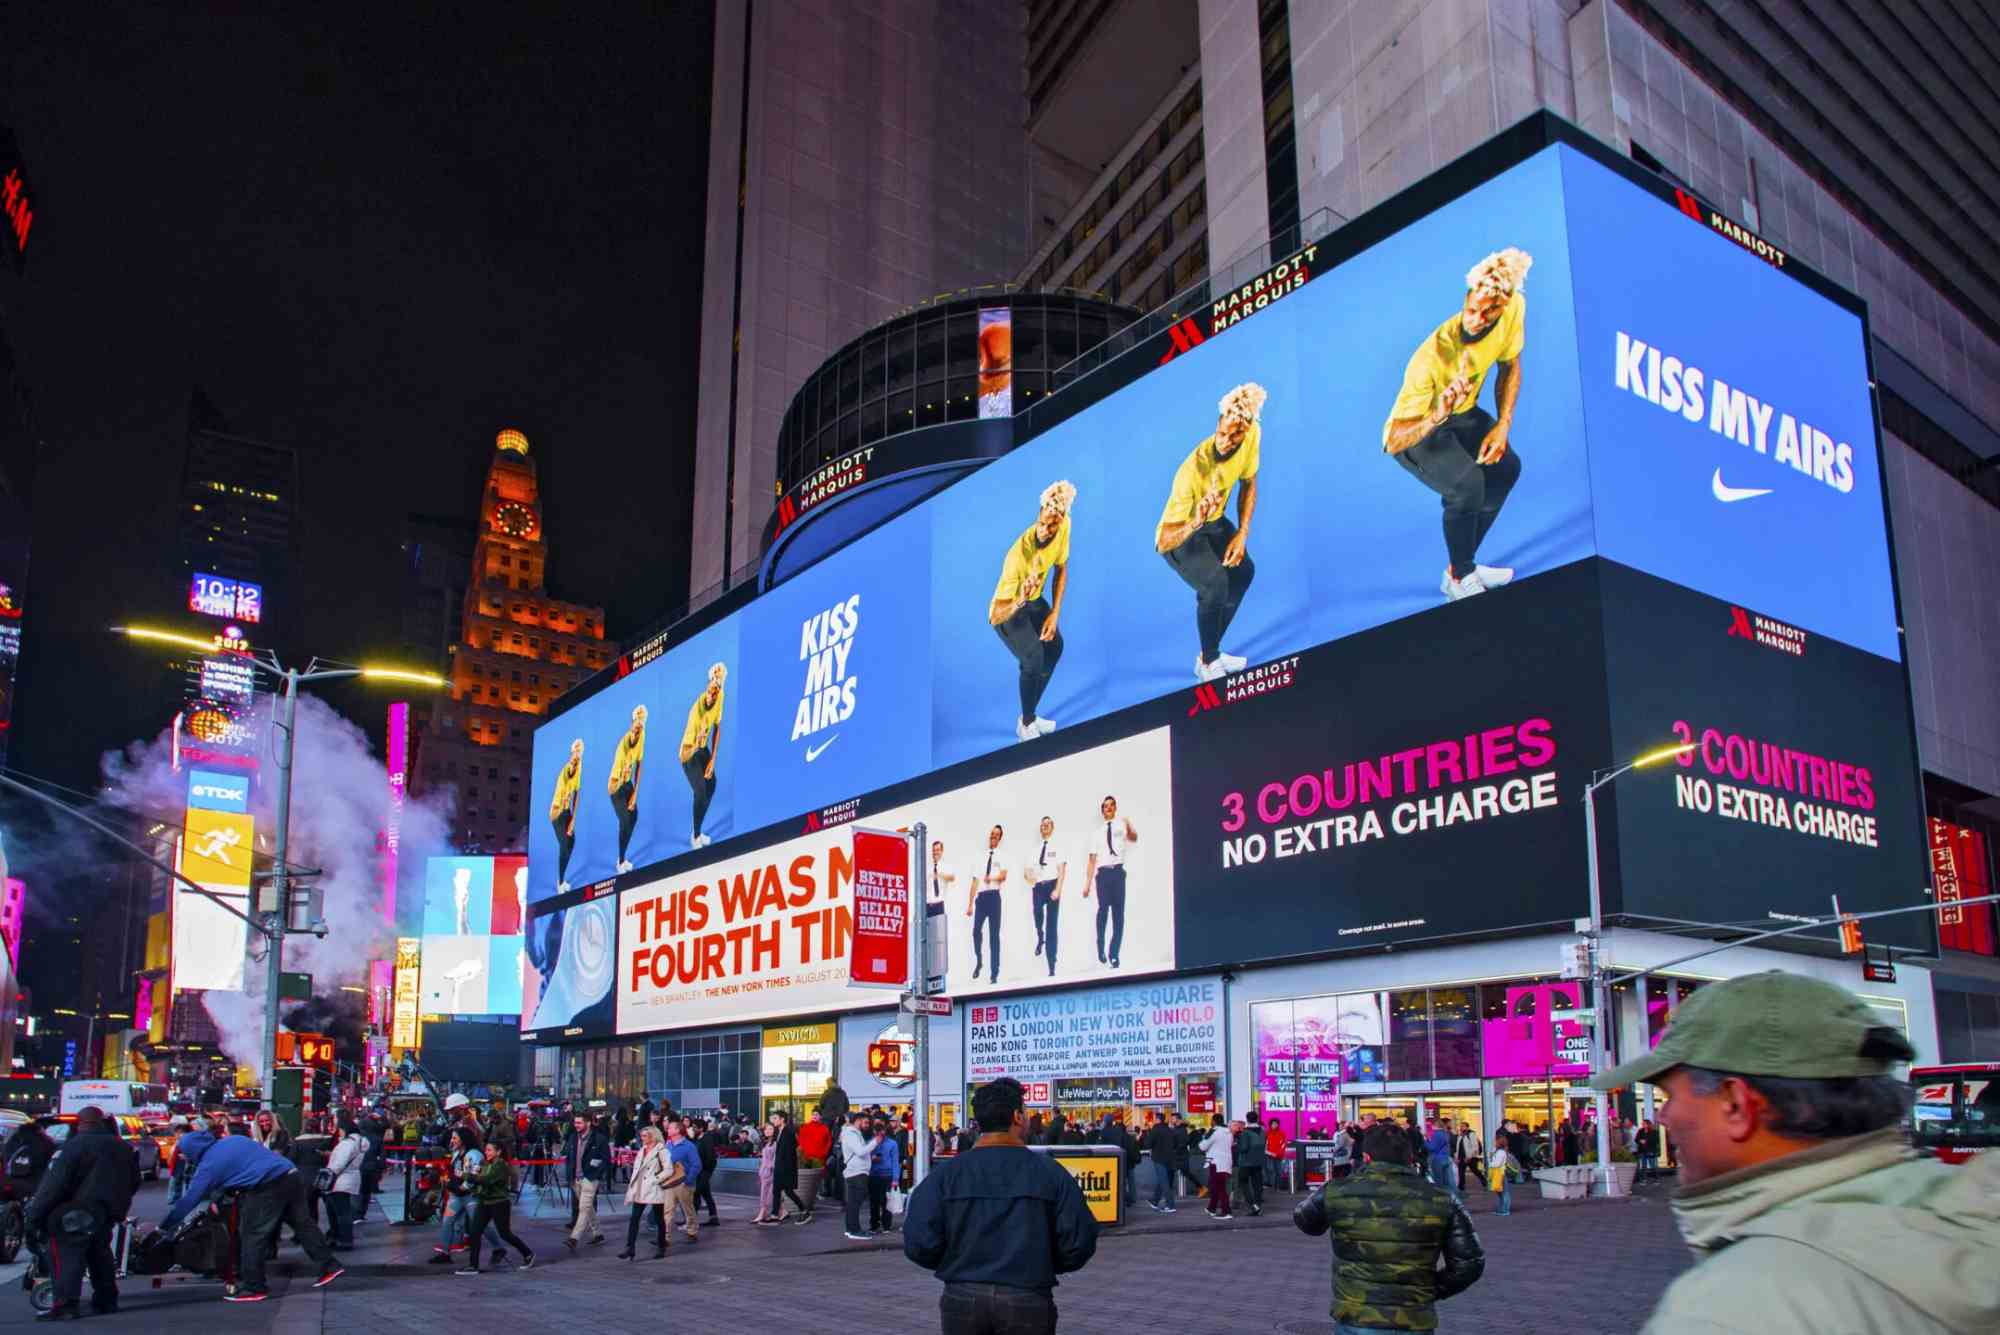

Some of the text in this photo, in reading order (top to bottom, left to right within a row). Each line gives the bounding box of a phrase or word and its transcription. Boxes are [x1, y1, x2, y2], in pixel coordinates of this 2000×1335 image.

[1711, 212, 1785, 266] MARRIOTT
[1213, 246, 1318, 317] MARRIOTT
[1213, 272, 1305, 333] MARQUIS
[1615, 330, 1854, 493] KISS MY AIRS
[802, 448, 874, 496] MARRIOTT
[801, 468, 863, 510] MARQUIS
[800, 594, 860, 662] KISS
[1755, 616, 1806, 642] MARRIOTT
[633, 632, 668, 659] MARRIOTT
[1756, 630, 1802, 655] MARQUIS
[804, 636, 855, 697] MY
[1226, 657, 1300, 689] MARRIOTT
[1226, 673, 1291, 701] MARQUIS
[791, 675, 857, 742] AIRS
[205, 732, 243, 746] 2017
[1221, 718, 1557, 832] 3 COUNTRIES
[1672, 720, 1876, 810] 3 COUNTRIES
[204, 785, 244, 801] TDK
[823, 799, 861, 817] MARRIOTT
[823, 809, 856, 826] MARQUIS
[1222, 771, 1558, 868] NO EXTRA CHARGE
[1675, 774, 1713, 814] NO
[1716, 783, 1792, 830] EXTRA
[1793, 801, 1878, 848] CHARGE
[718, 855, 816, 925] WAS
[829, 846, 854, 900] M
[858, 869, 905, 888] BETTE
[856, 883, 907, 903] MIDLER
[631, 920, 781, 993] FOURTH
[705, 987, 721, 999] THE
[721, 984, 740, 996] NEW
[741, 981, 764, 993] YORK
[766, 976, 791, 989] TIMES
[795, 969, 833, 984] AUGUST
[1003, 1001, 1051, 1020] TOKYO
[1056, 998, 1075, 1015] TO
[1083, 991, 1132, 1013] TIMES
[1140, 983, 1215, 1009] SQUARE
[971, 1005, 1214, 1040] PARIS LONDON NEW YORK UNIQLO
[971, 1025, 1215, 1053] HONG KONG TORONTO SHANGHAI CHICAGO
[971, 1041, 1215, 1065] LOS ANGELES SINGAPORE ANTWERP SEOUL MELBOURNE
[1566, 1038, 1589, 1049] ONE
[888, 1051, 899, 1068] 10
[1091, 1060, 1120, 1068] MOSCOW
[1155, 1057, 1170, 1066] SAN
[1172, 1055, 1215, 1065] FRANCISCO
[1268, 1061, 1285, 1073] ALL
[1057, 1087, 1130, 1099] LifeWear Pop-Up
[1155, 1080, 1170, 1088] UNI
[1155, 1088, 1171, 1097] QLO
[1269, 1094, 1290, 1108] ALL
[1075, 1170, 1111, 1190] tiful
